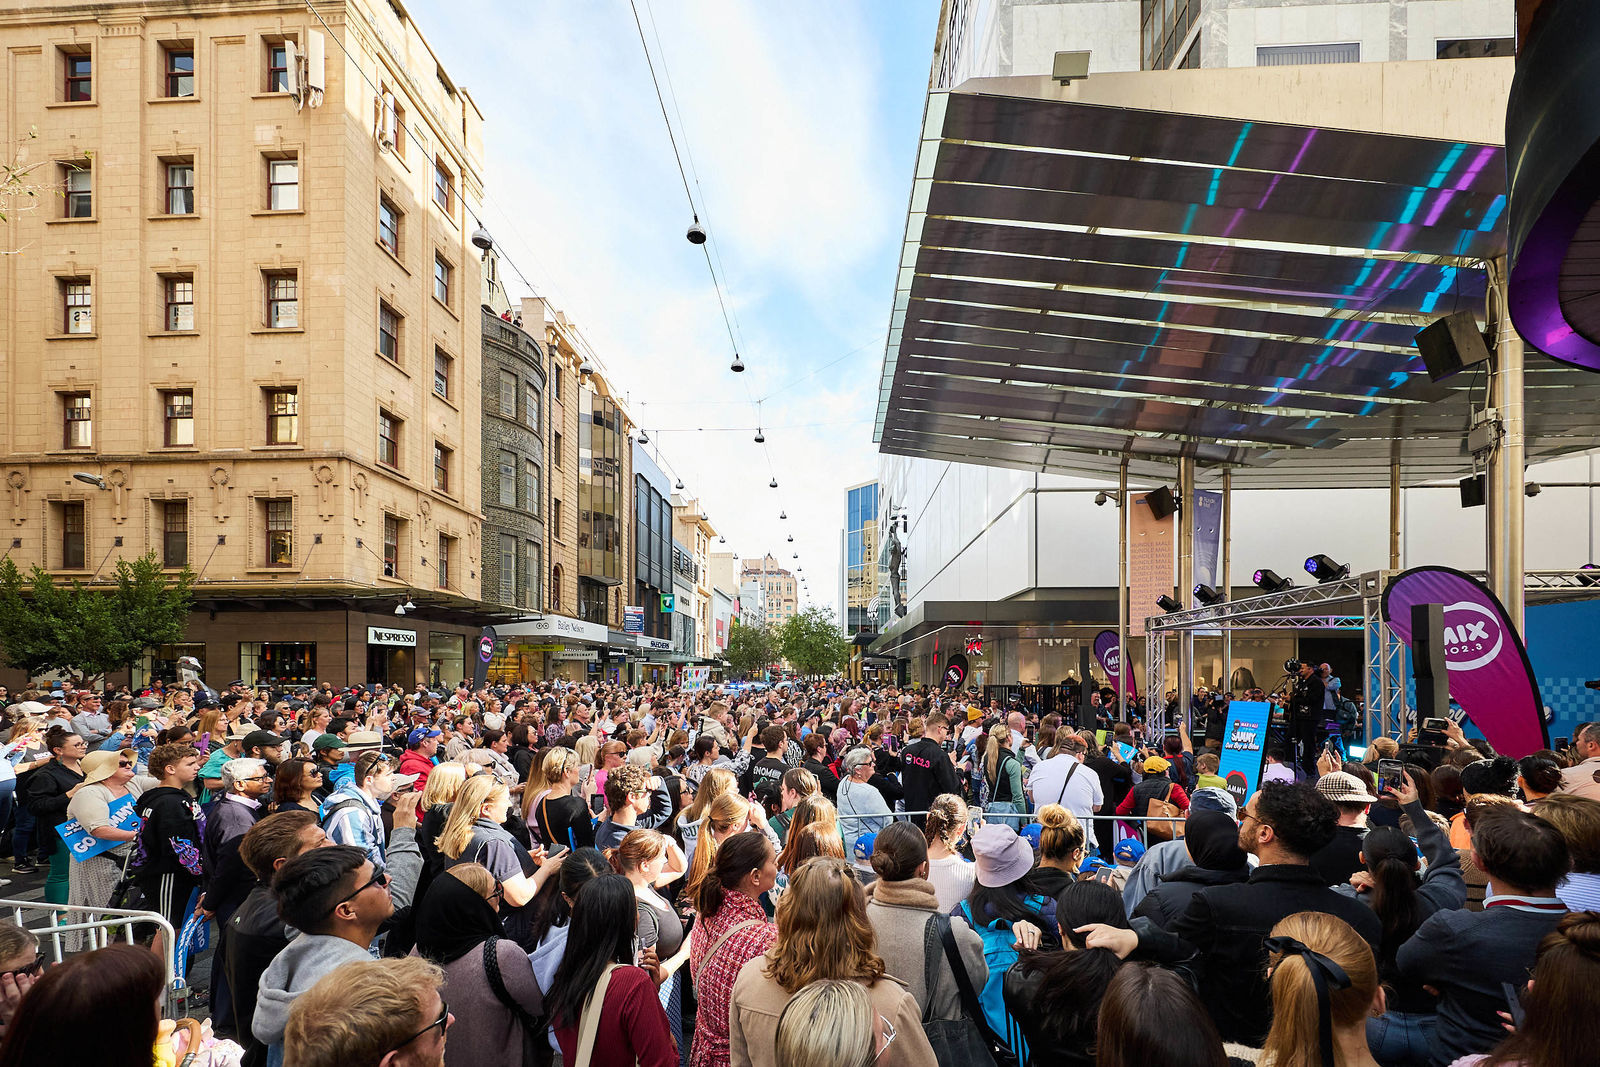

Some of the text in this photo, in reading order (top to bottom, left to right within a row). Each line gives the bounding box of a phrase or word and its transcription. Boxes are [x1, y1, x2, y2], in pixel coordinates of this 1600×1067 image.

[558, 620, 585, 633] Bailey Nelson
[373, 630, 415, 642] NESPRESSO
[1107, 655, 1120, 666] MI
[947, 669, 961, 683] MIX
[1231, 732, 1256, 744] SAMMY
[1226, 783, 1247, 795] AMMY
[73, 836, 97, 853] GO
